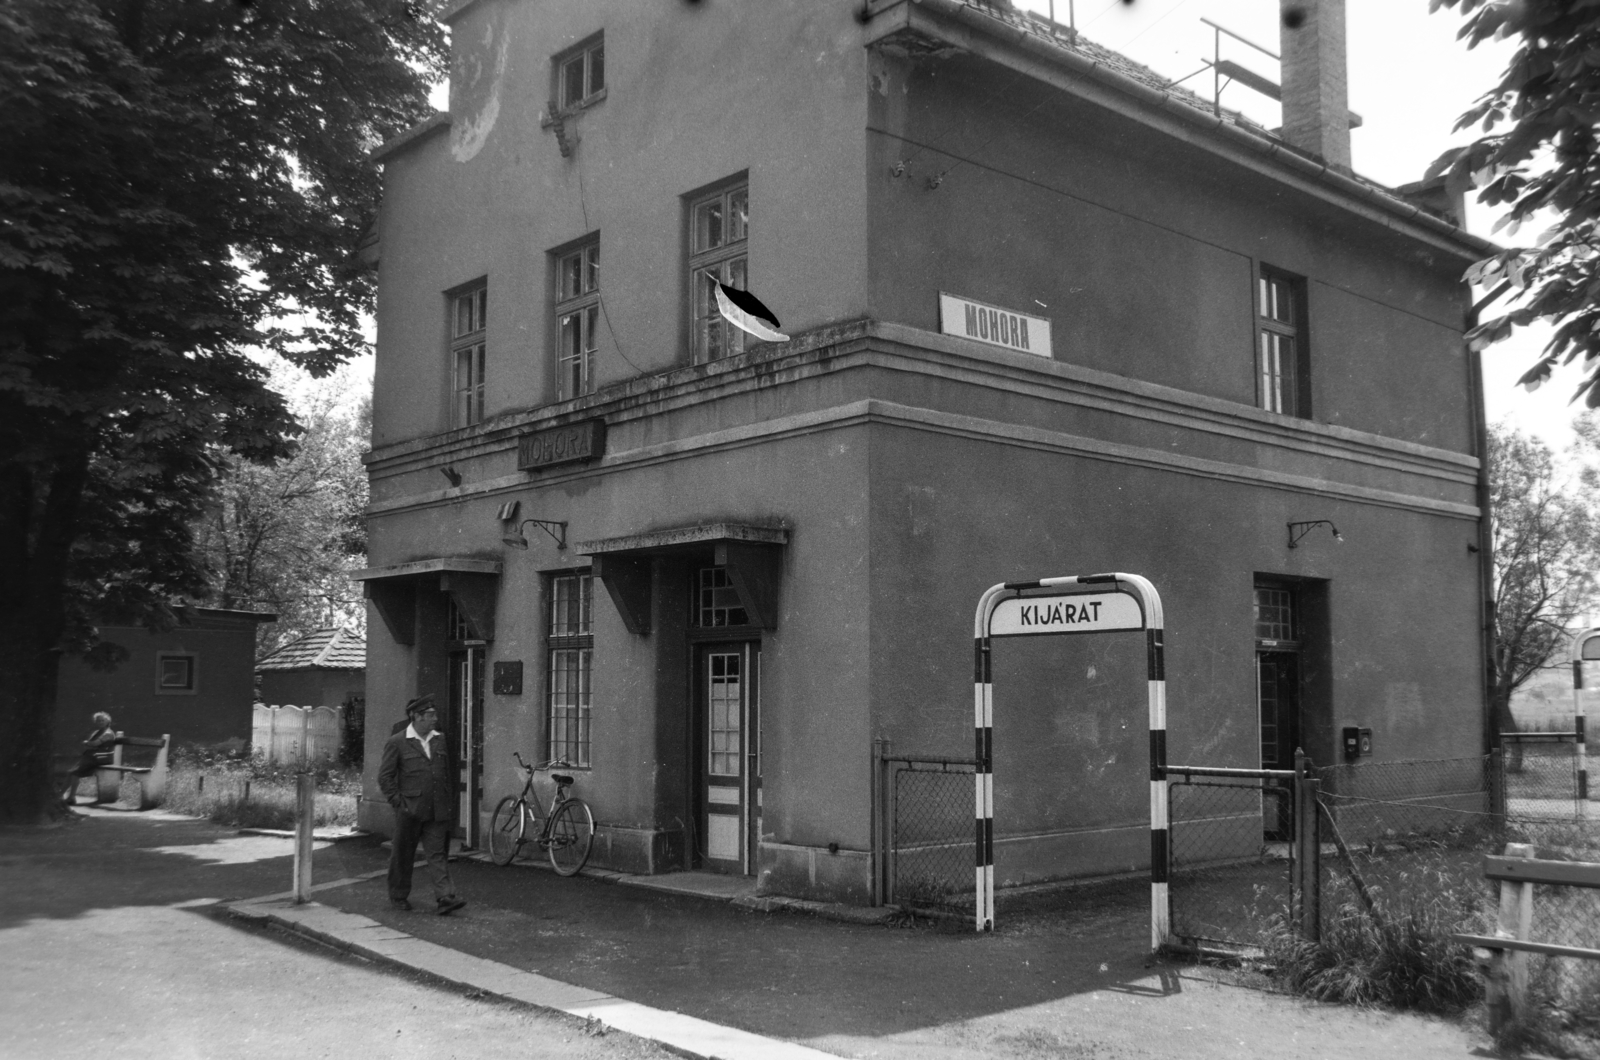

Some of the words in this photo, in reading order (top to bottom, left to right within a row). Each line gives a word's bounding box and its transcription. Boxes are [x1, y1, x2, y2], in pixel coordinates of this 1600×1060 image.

[964, 303, 1030, 351] MOHORA
[519, 427, 592, 467] MOHORA
[1021, 601, 1102, 626] KIJÁRAT
